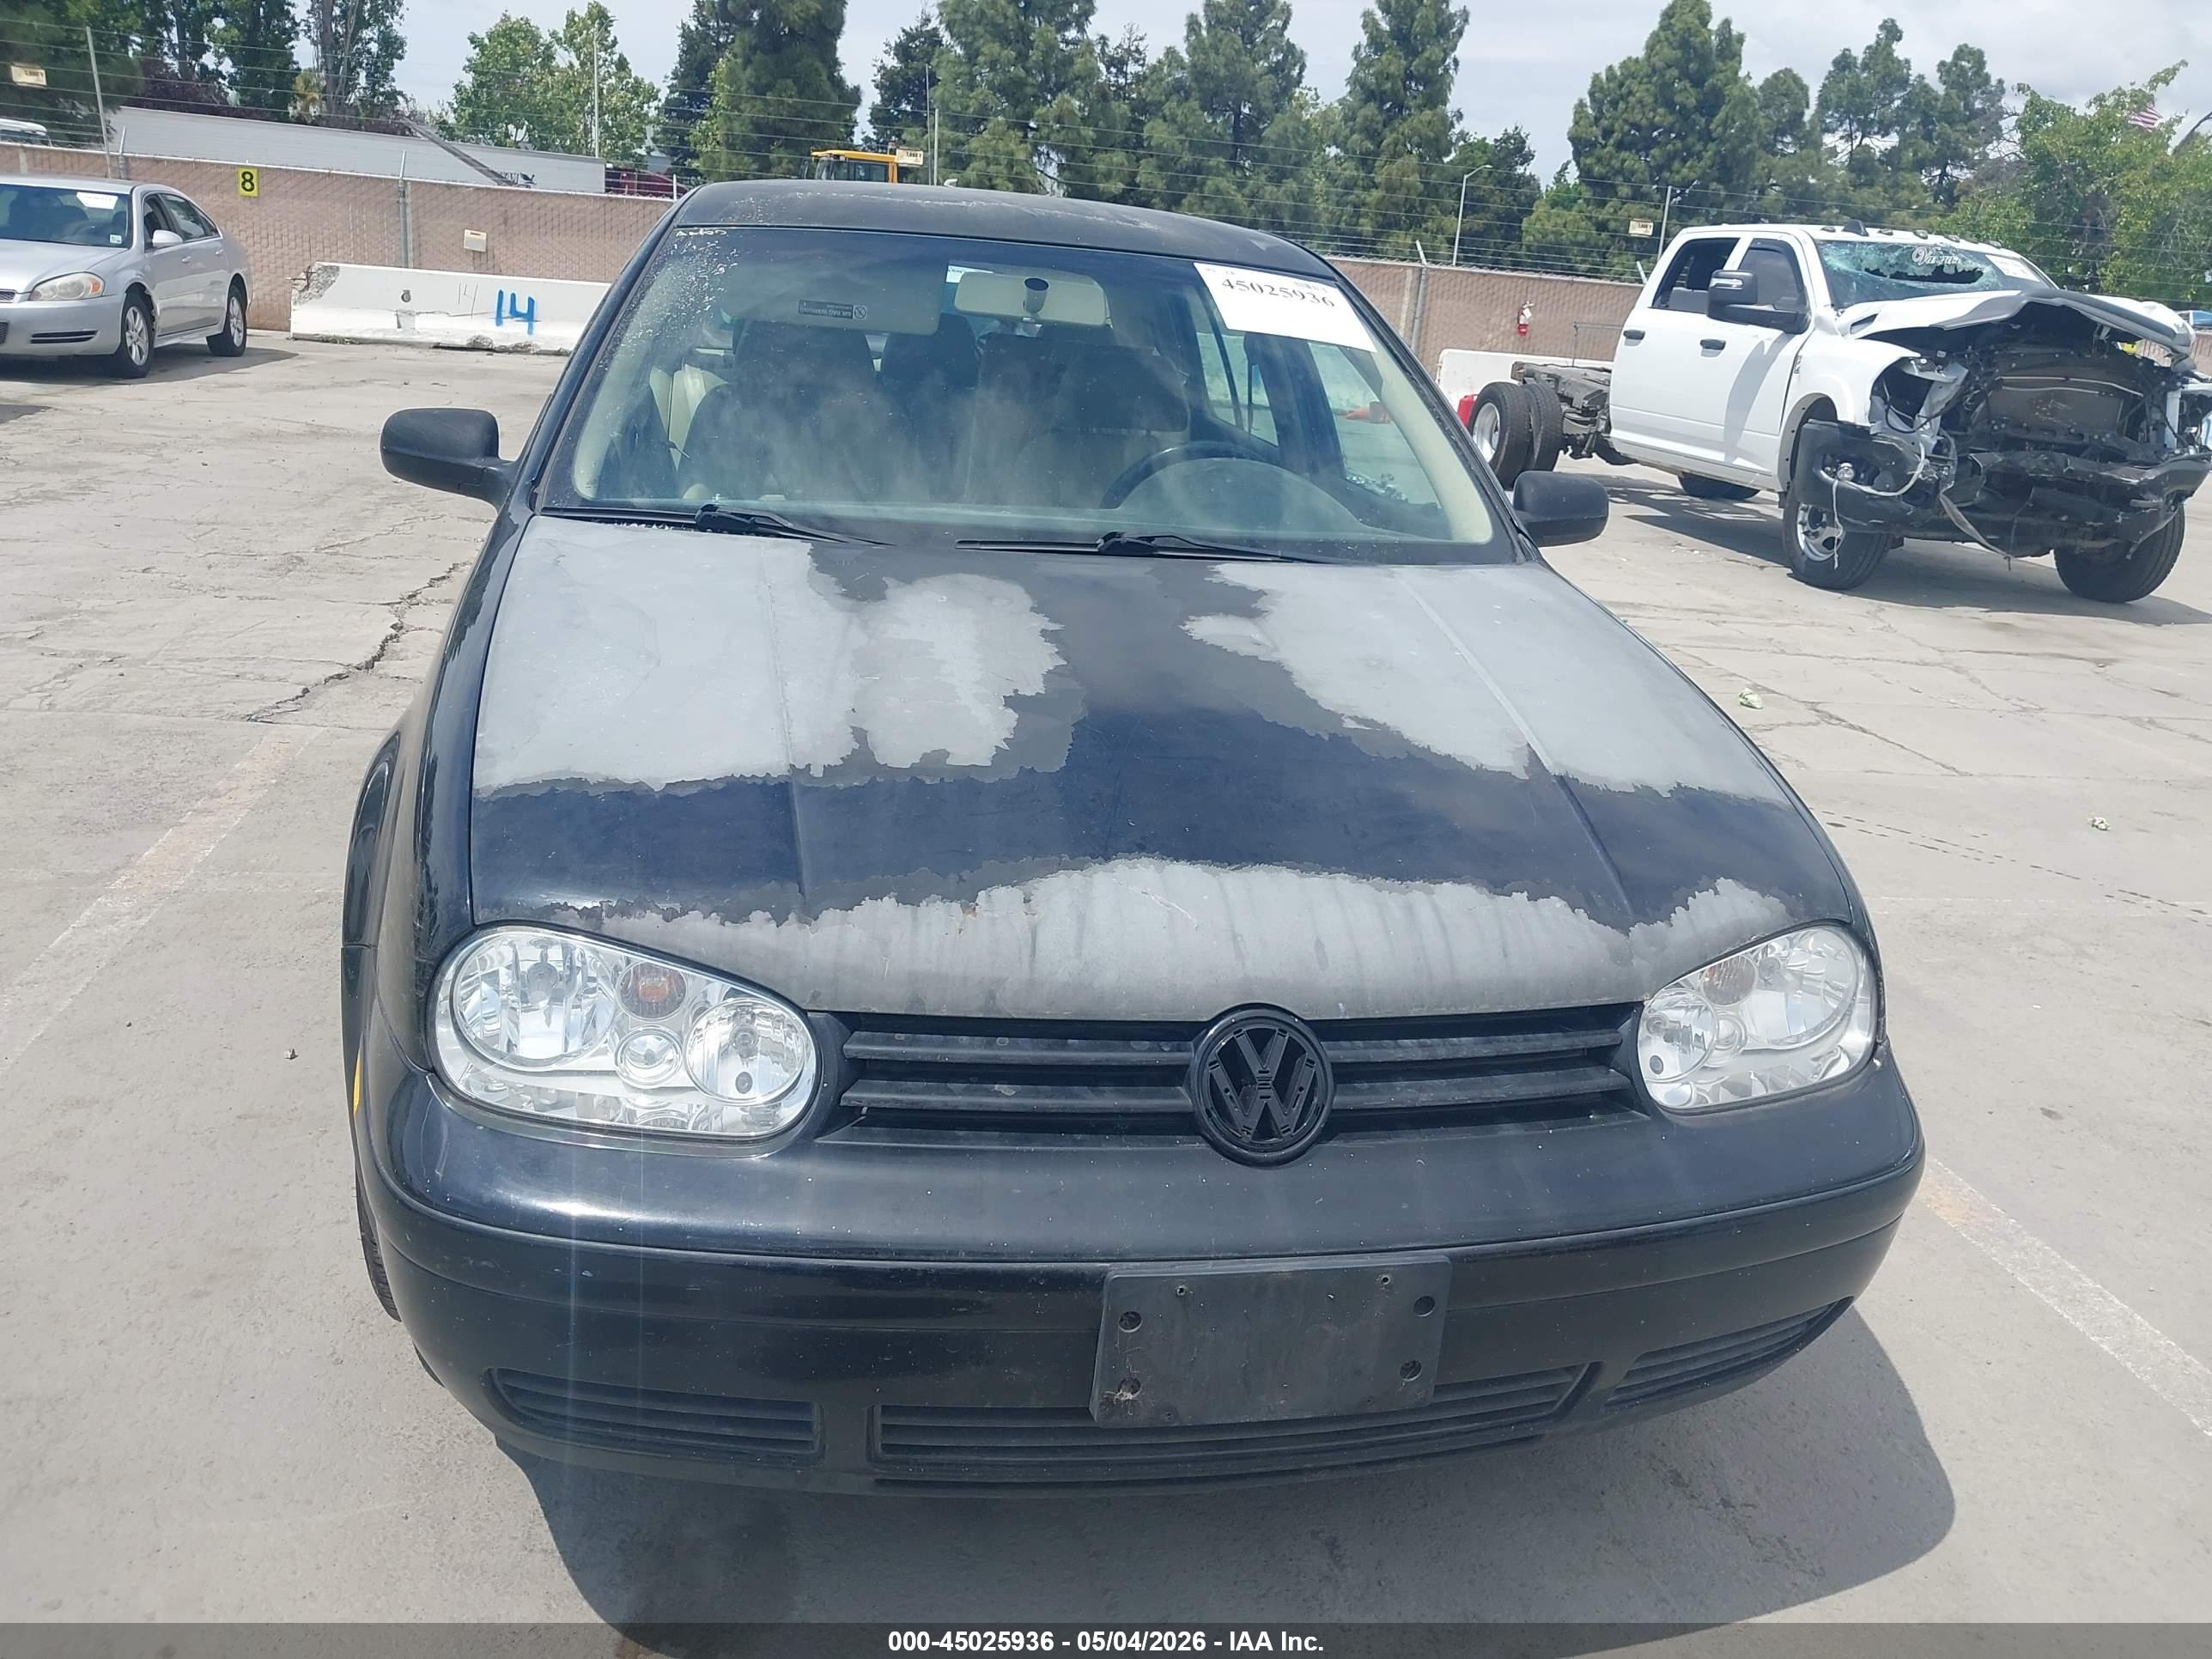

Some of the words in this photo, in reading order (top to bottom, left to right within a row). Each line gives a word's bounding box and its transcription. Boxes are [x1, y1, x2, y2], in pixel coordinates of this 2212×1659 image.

[241, 171, 254, 192] 8
[1222, 278, 1334, 307] 45025936
[495, 289, 535, 335] 14
[1206, 1026, 1319, 1142] VW
